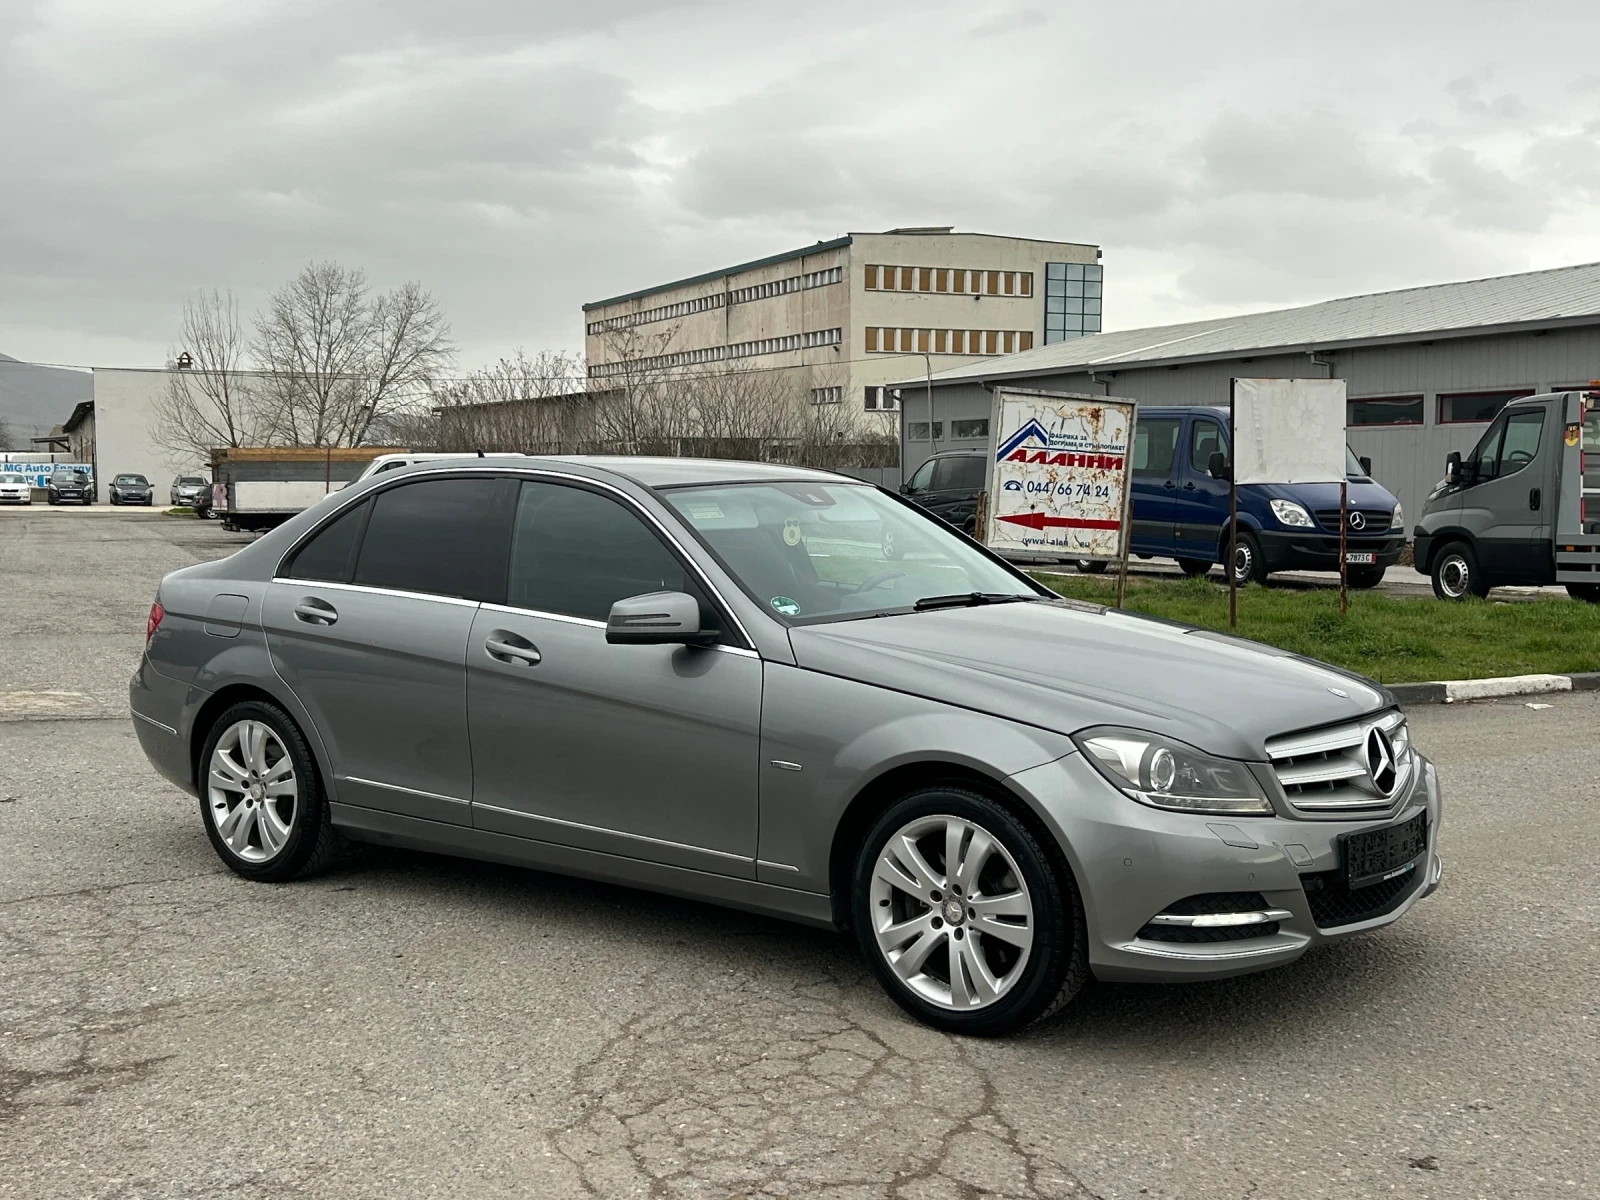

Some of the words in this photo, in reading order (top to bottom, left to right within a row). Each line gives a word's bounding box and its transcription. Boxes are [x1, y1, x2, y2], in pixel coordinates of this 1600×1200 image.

[1050, 432, 1078, 440] ФАБРИКА
[1049, 440, 1077, 448] ДОГРАМА
[1006, 449, 1123, 470] АЛАННИ
[4, 464, 22, 472] MG
[25, 464, 51, 472] Auto
[1095, 486, 1109, 498] 24
